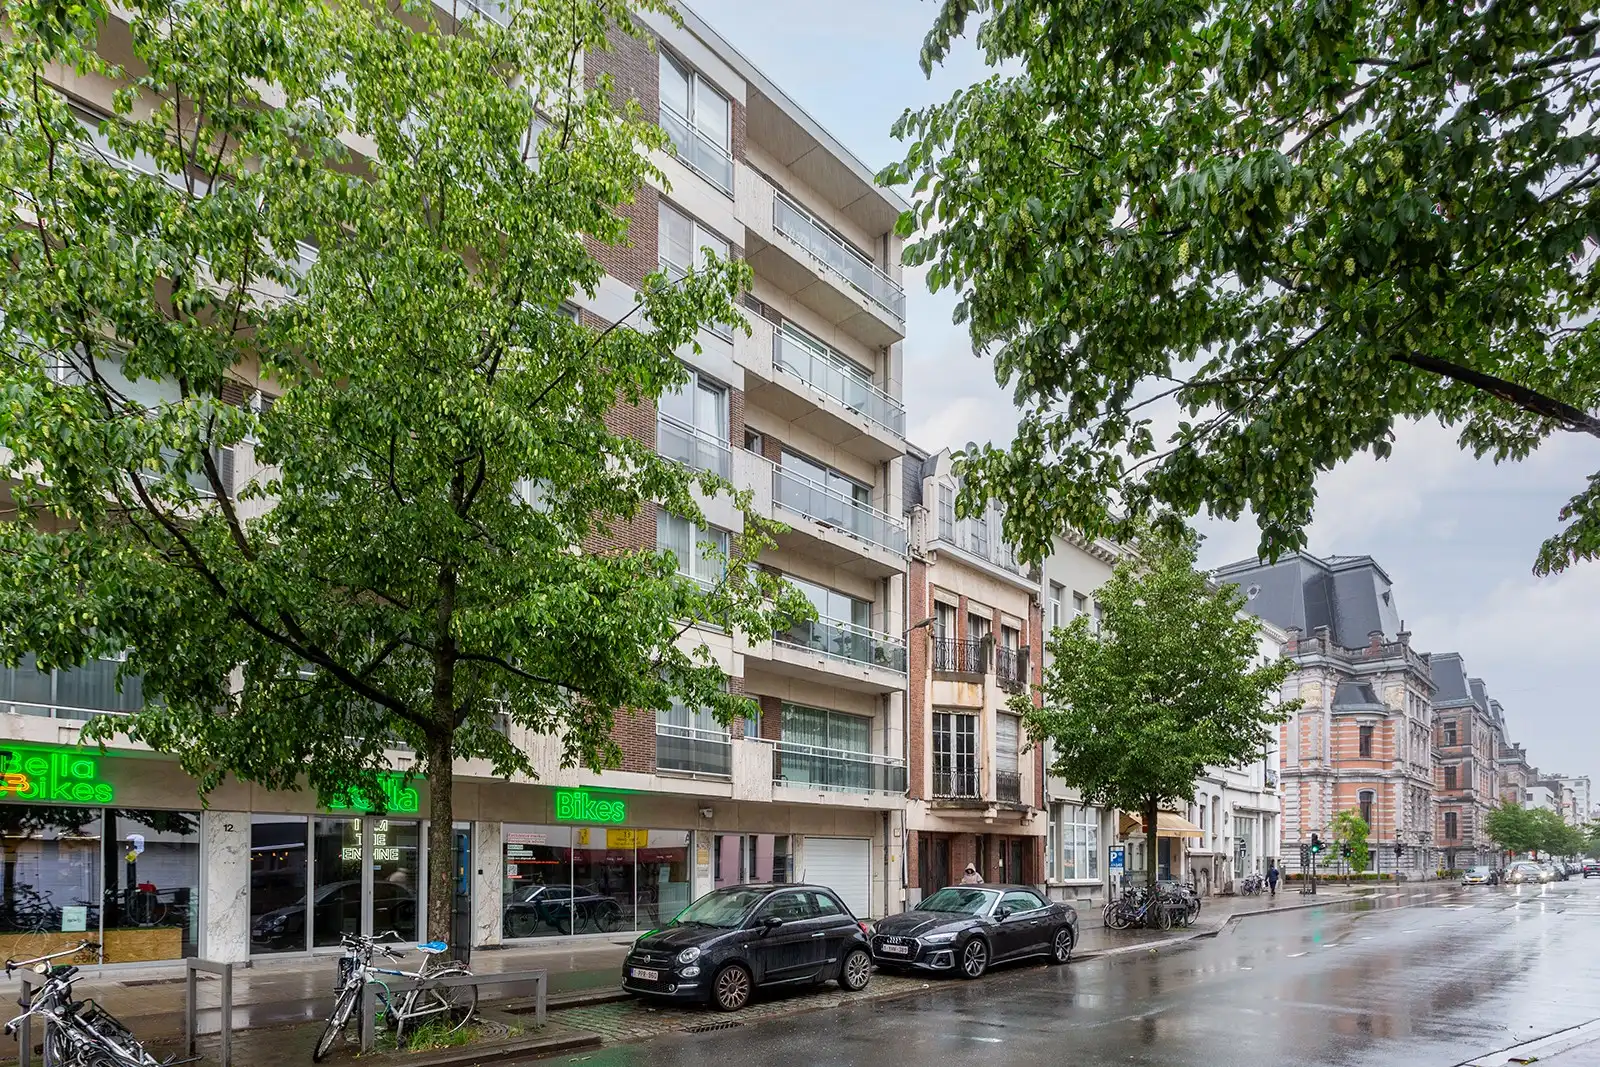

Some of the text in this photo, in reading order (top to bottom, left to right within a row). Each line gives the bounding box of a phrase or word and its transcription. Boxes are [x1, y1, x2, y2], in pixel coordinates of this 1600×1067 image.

[1, 751, 94, 778] Bella
[557, 792, 625, 821] Bikes
[223, 823, 234, 832] 12
[342, 848, 399, 860] ENINE
[1111, 852, 1118, 862] P
